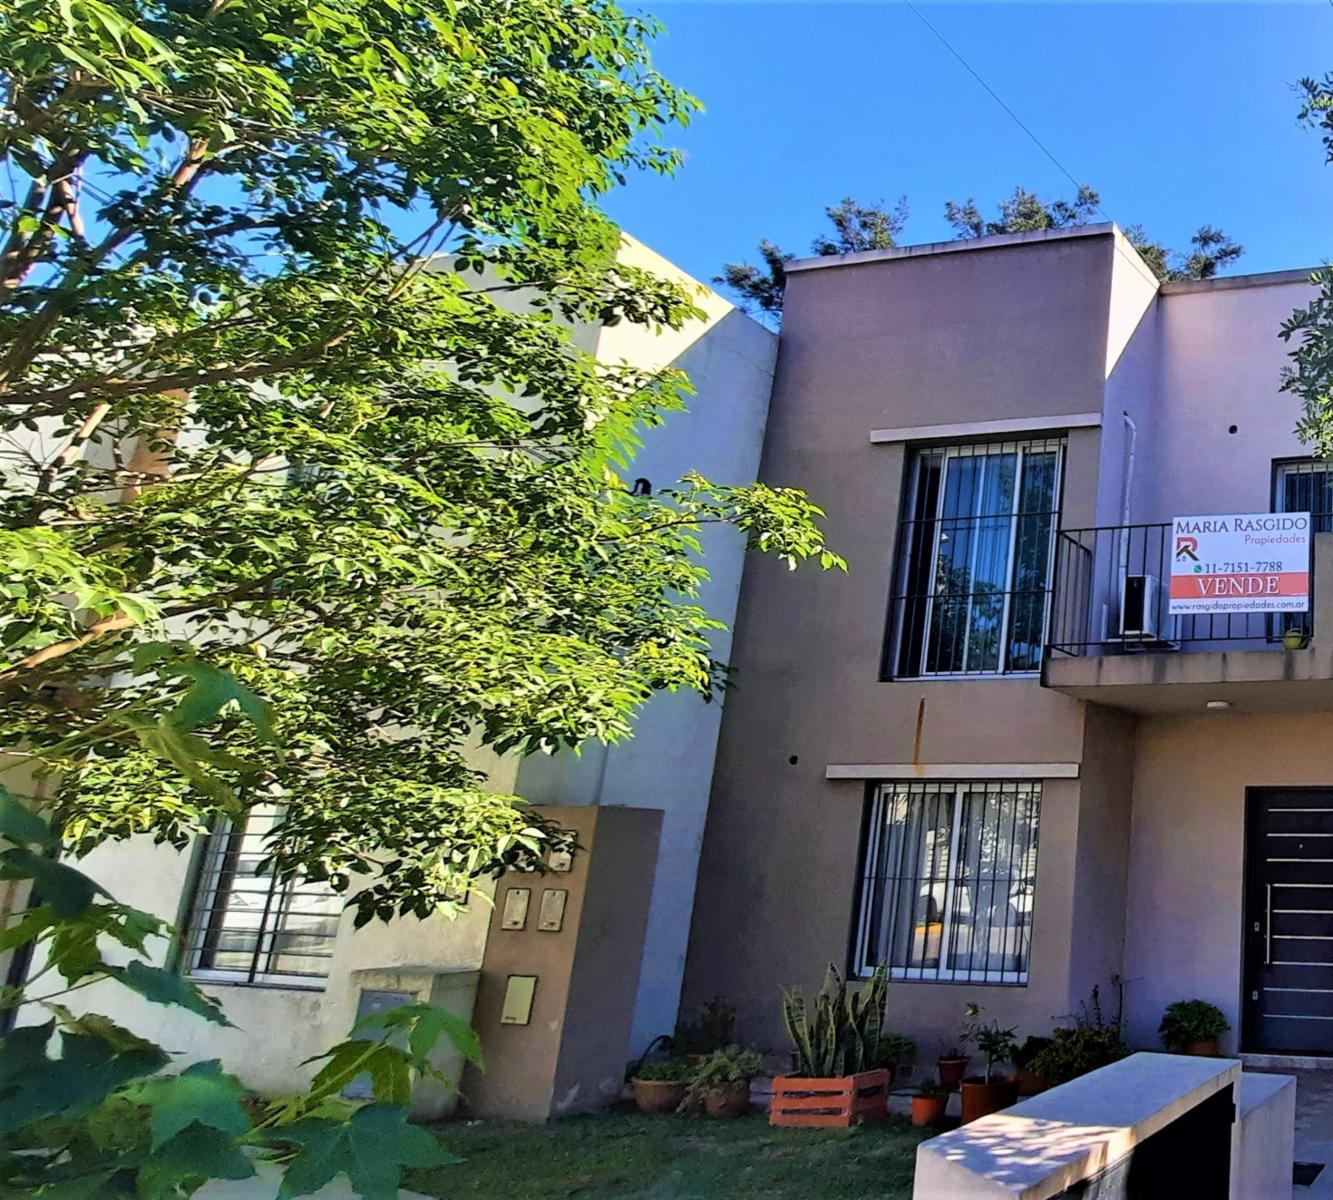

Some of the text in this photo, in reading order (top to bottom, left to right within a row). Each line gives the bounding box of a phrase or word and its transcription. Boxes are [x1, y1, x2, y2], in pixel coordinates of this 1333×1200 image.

[1176, 517, 1307, 534] MARIA RASGIDO
[1244, 534, 1306, 545] Propiedades
[1205, 561, 1283, 573] 11-7151-7788
[1197, 576, 1280, 596] VENDE
[1172, 600, 1305, 611] www.rasgidopropiedades.com.ar
